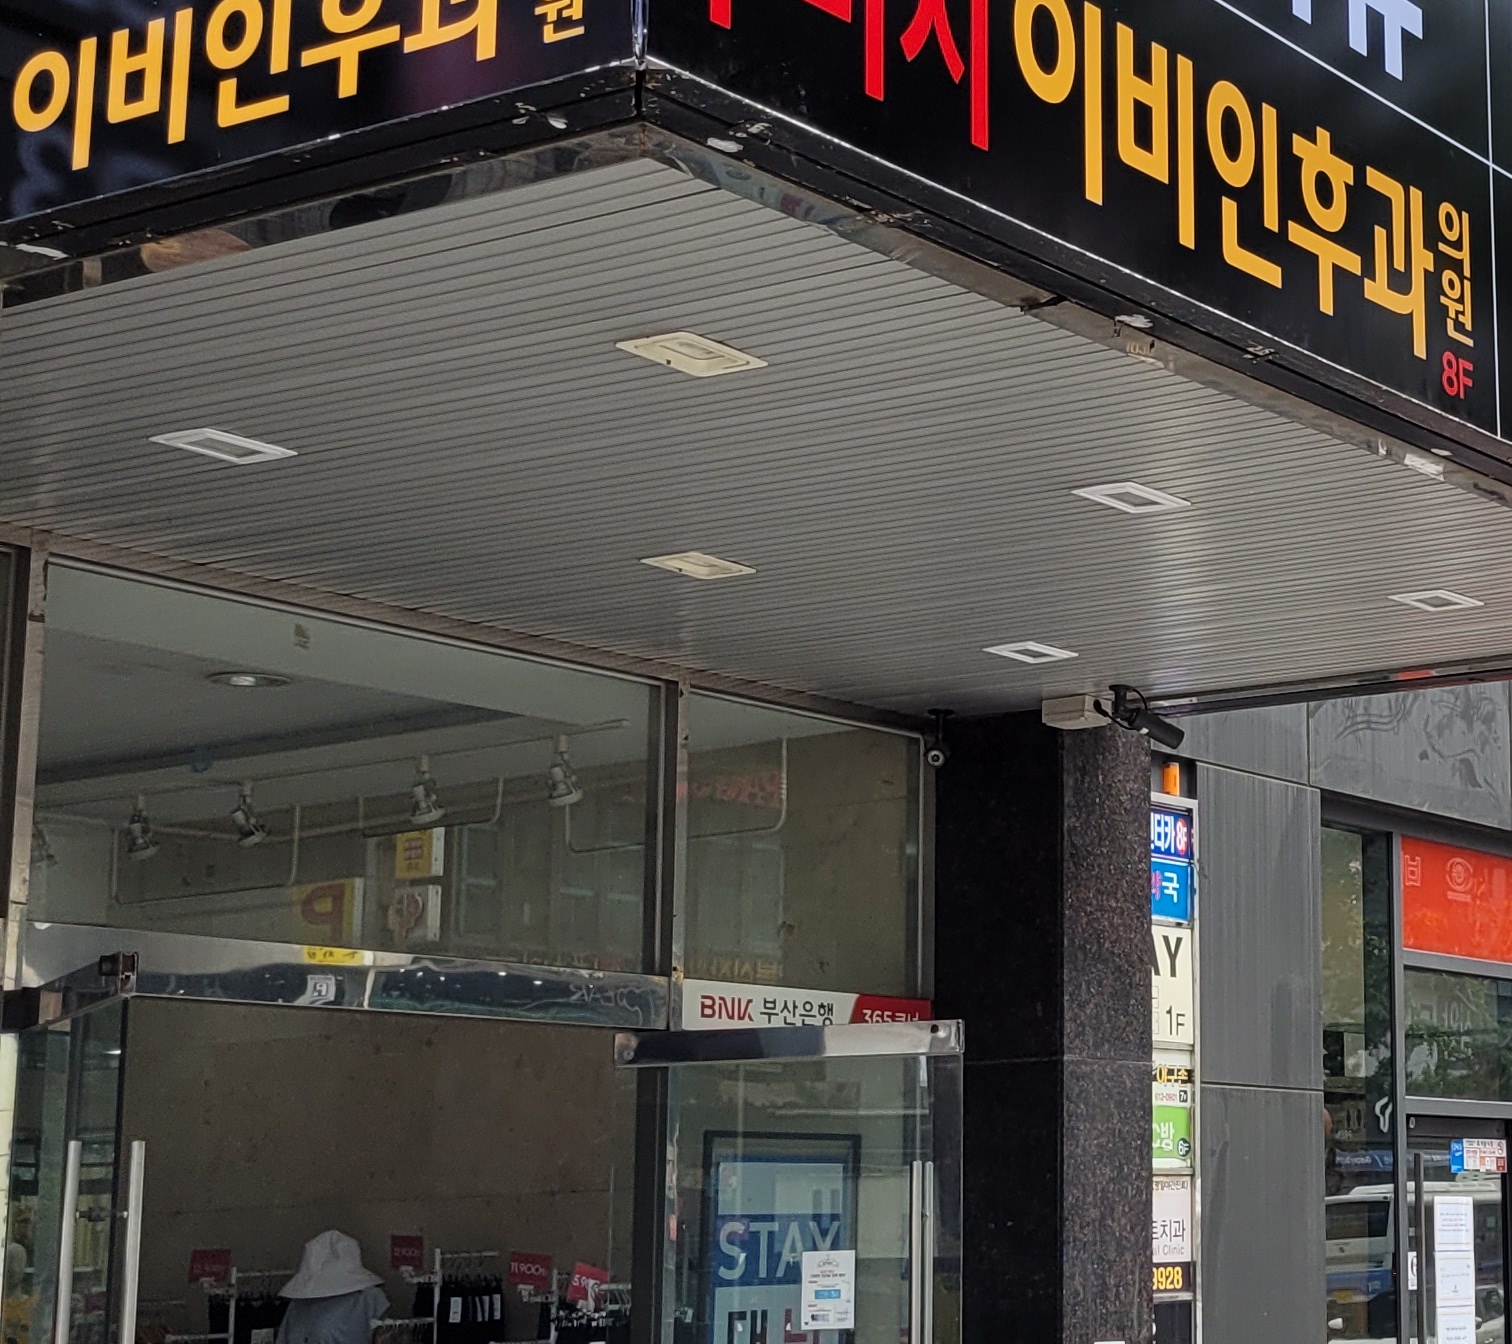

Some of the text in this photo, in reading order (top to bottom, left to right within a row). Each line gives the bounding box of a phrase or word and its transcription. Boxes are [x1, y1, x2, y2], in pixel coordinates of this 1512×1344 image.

[1437, 200, 1474, 349] 의원
[1441, 350, 1474, 399] 8F
[700, 995, 834, 1026] BNK 부산은행
[1166, 1004, 1186, 1037] 1F
[1157, 1063, 1188, 1085] 야구존
